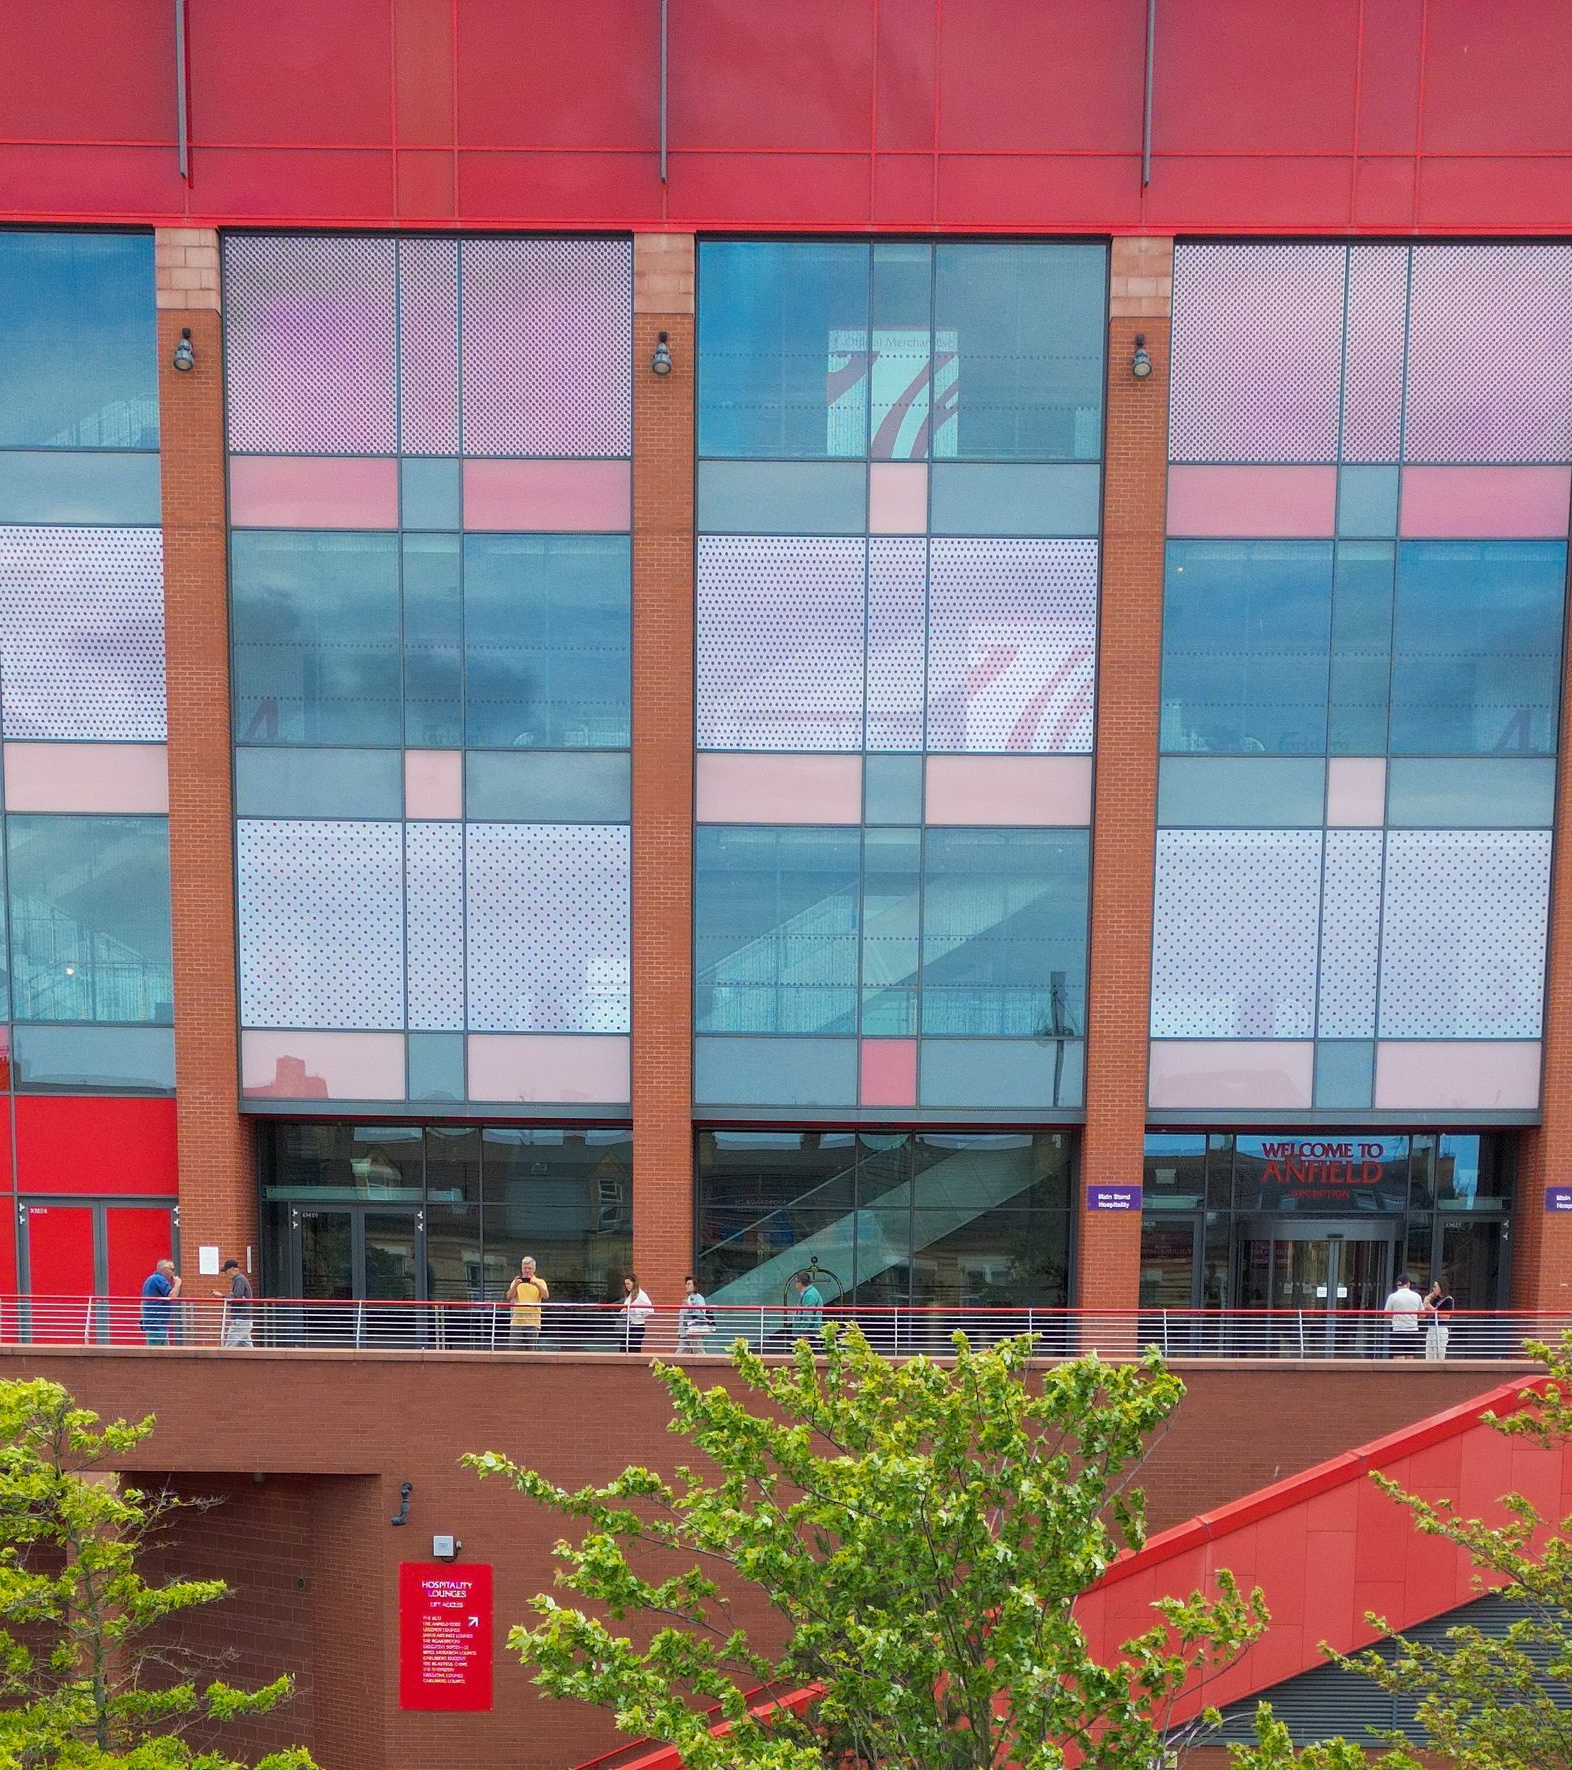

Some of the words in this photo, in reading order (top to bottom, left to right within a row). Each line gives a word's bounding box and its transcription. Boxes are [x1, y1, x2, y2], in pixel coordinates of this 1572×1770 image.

[1261, 1143, 1354, 1160] WELCOME
[1358, 1143, 1384, 1159] TO
[1261, 1160, 1384, 1184] ANFIELD
[1098, 1193, 1113, 1201] Main
[1114, 1193, 1131, 1201] Stand
[1556, 1194, 1571, 1202] Main
[1098, 1201, 1130, 1210] Hospitality
[421, 1581, 472, 1590] HOSPITALITY
[427, 1590, 467, 1598] LOUNGES
